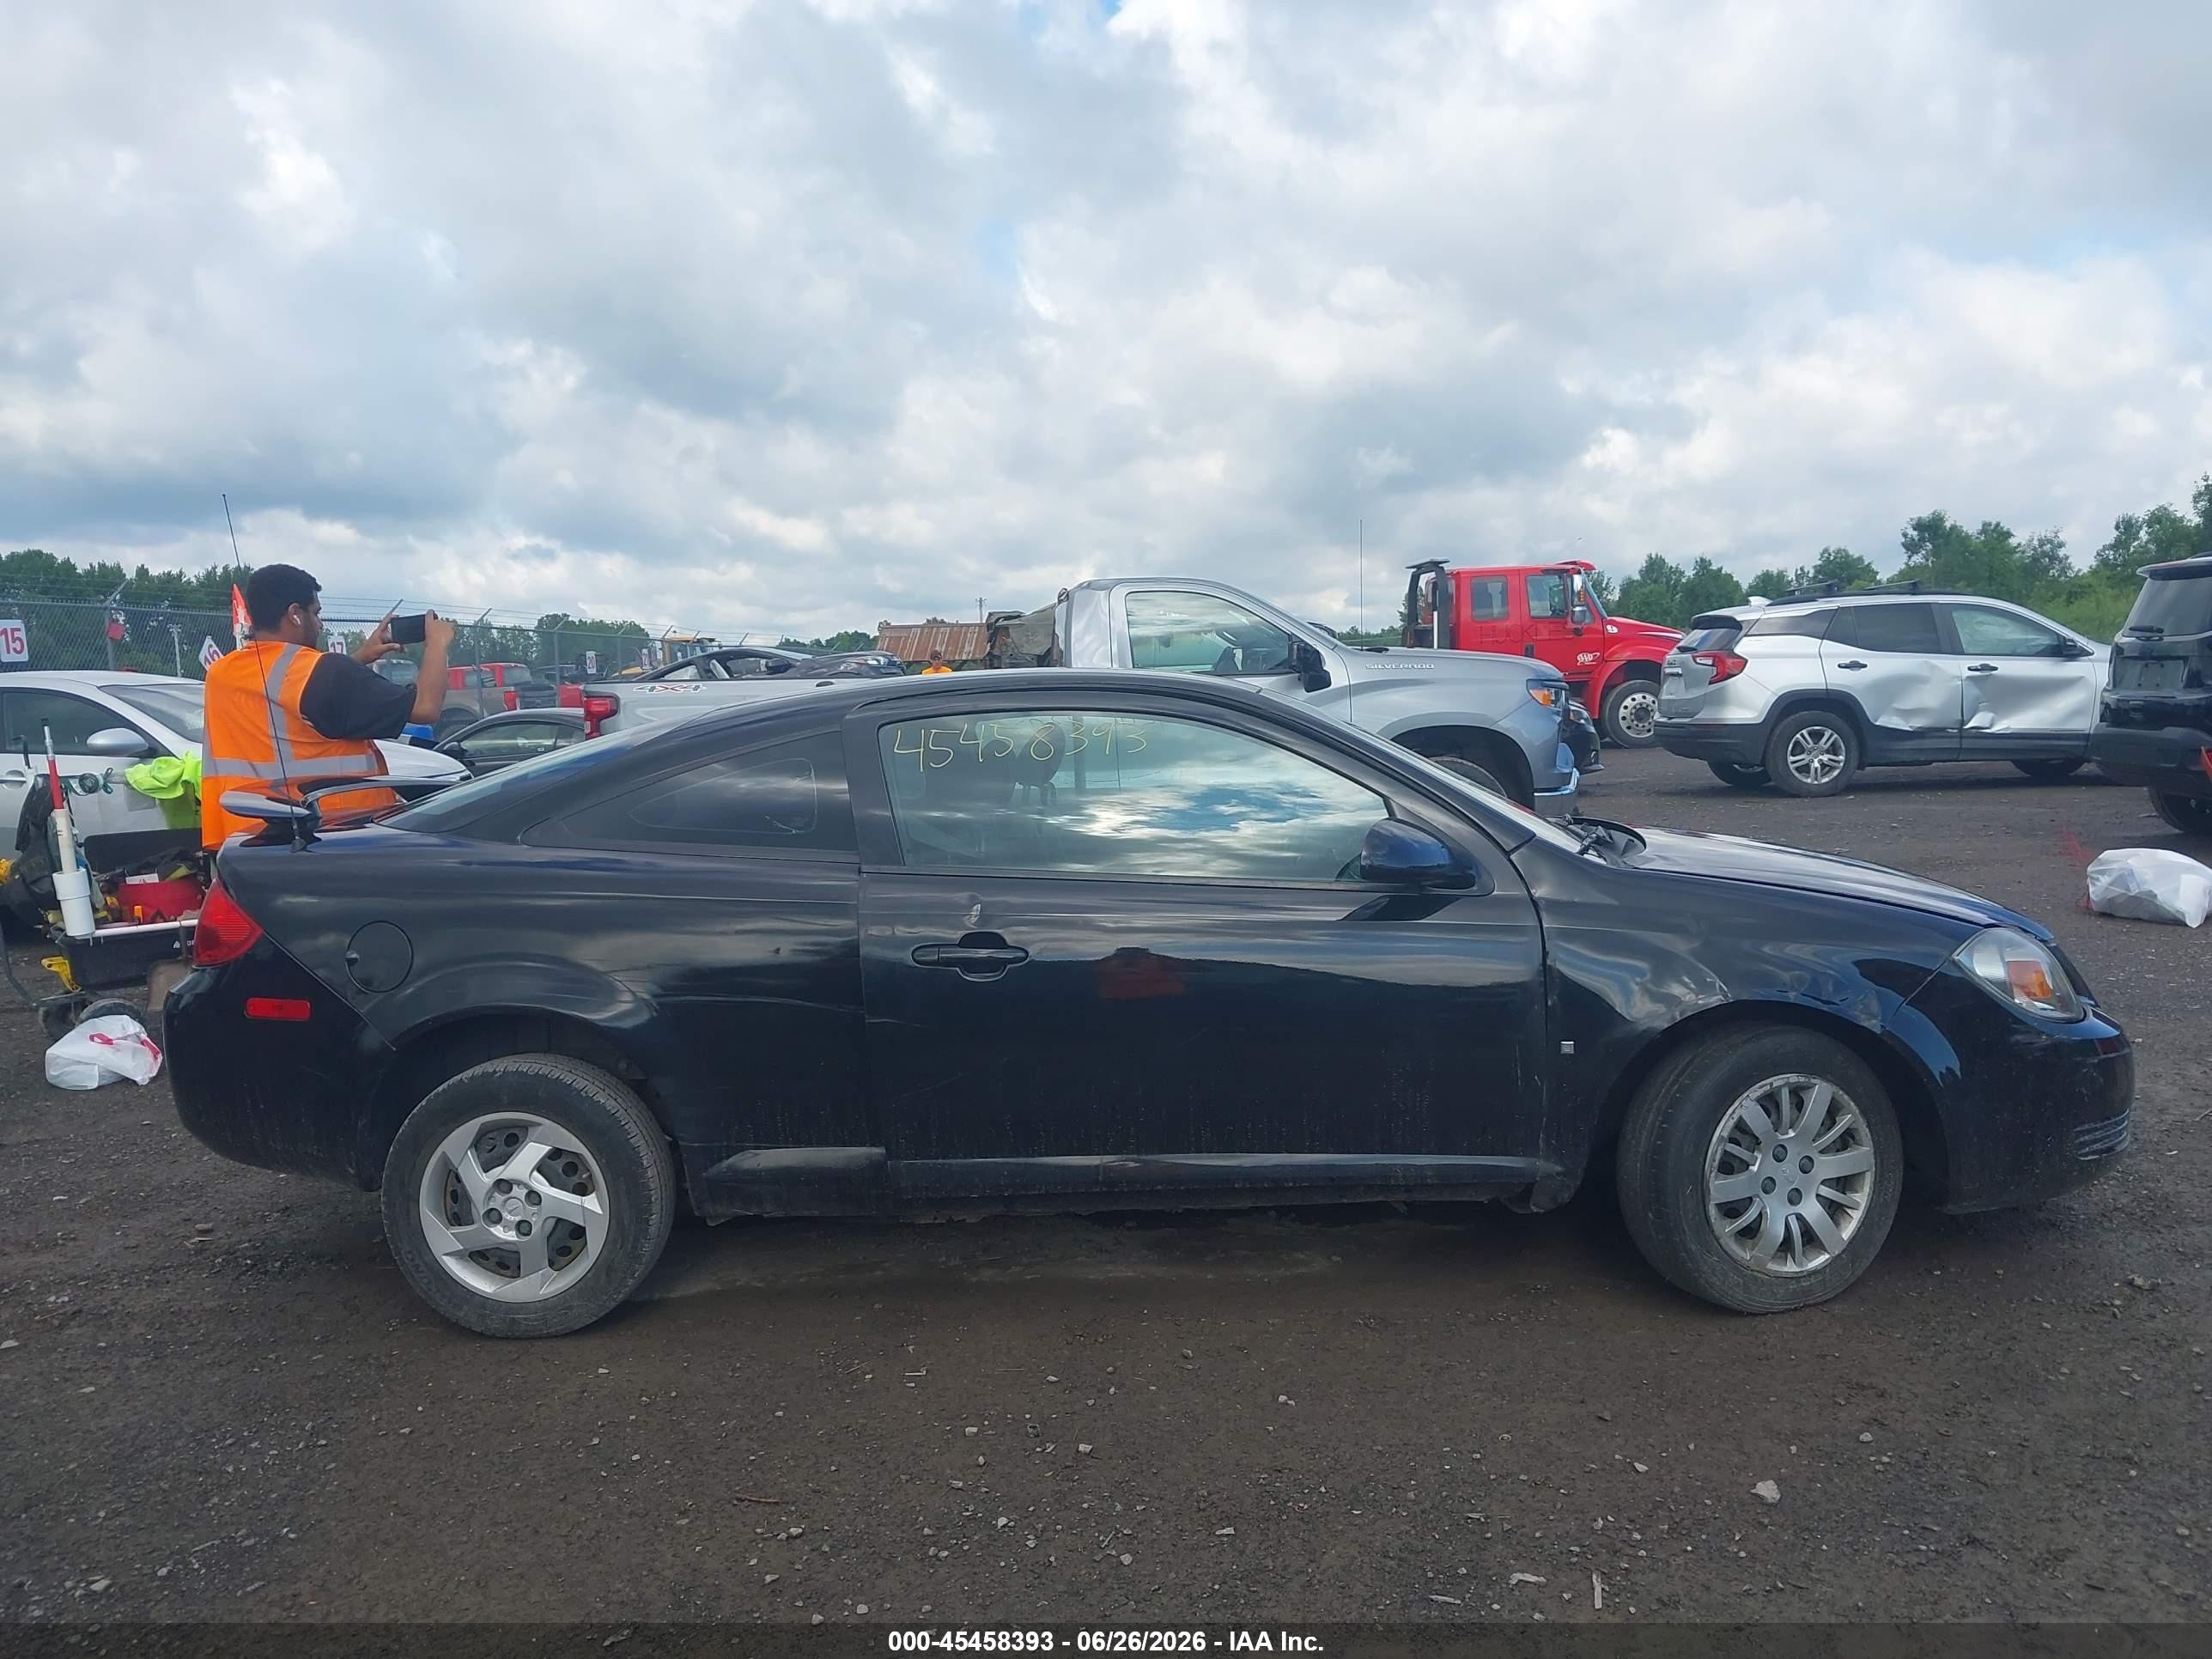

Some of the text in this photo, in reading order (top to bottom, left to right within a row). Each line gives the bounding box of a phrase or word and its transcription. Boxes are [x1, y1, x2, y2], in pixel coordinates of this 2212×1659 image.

[0, 628, 25, 654] 15
[587, 655, 595, 669] 20
[893, 721, 1147, 772] 45458393
